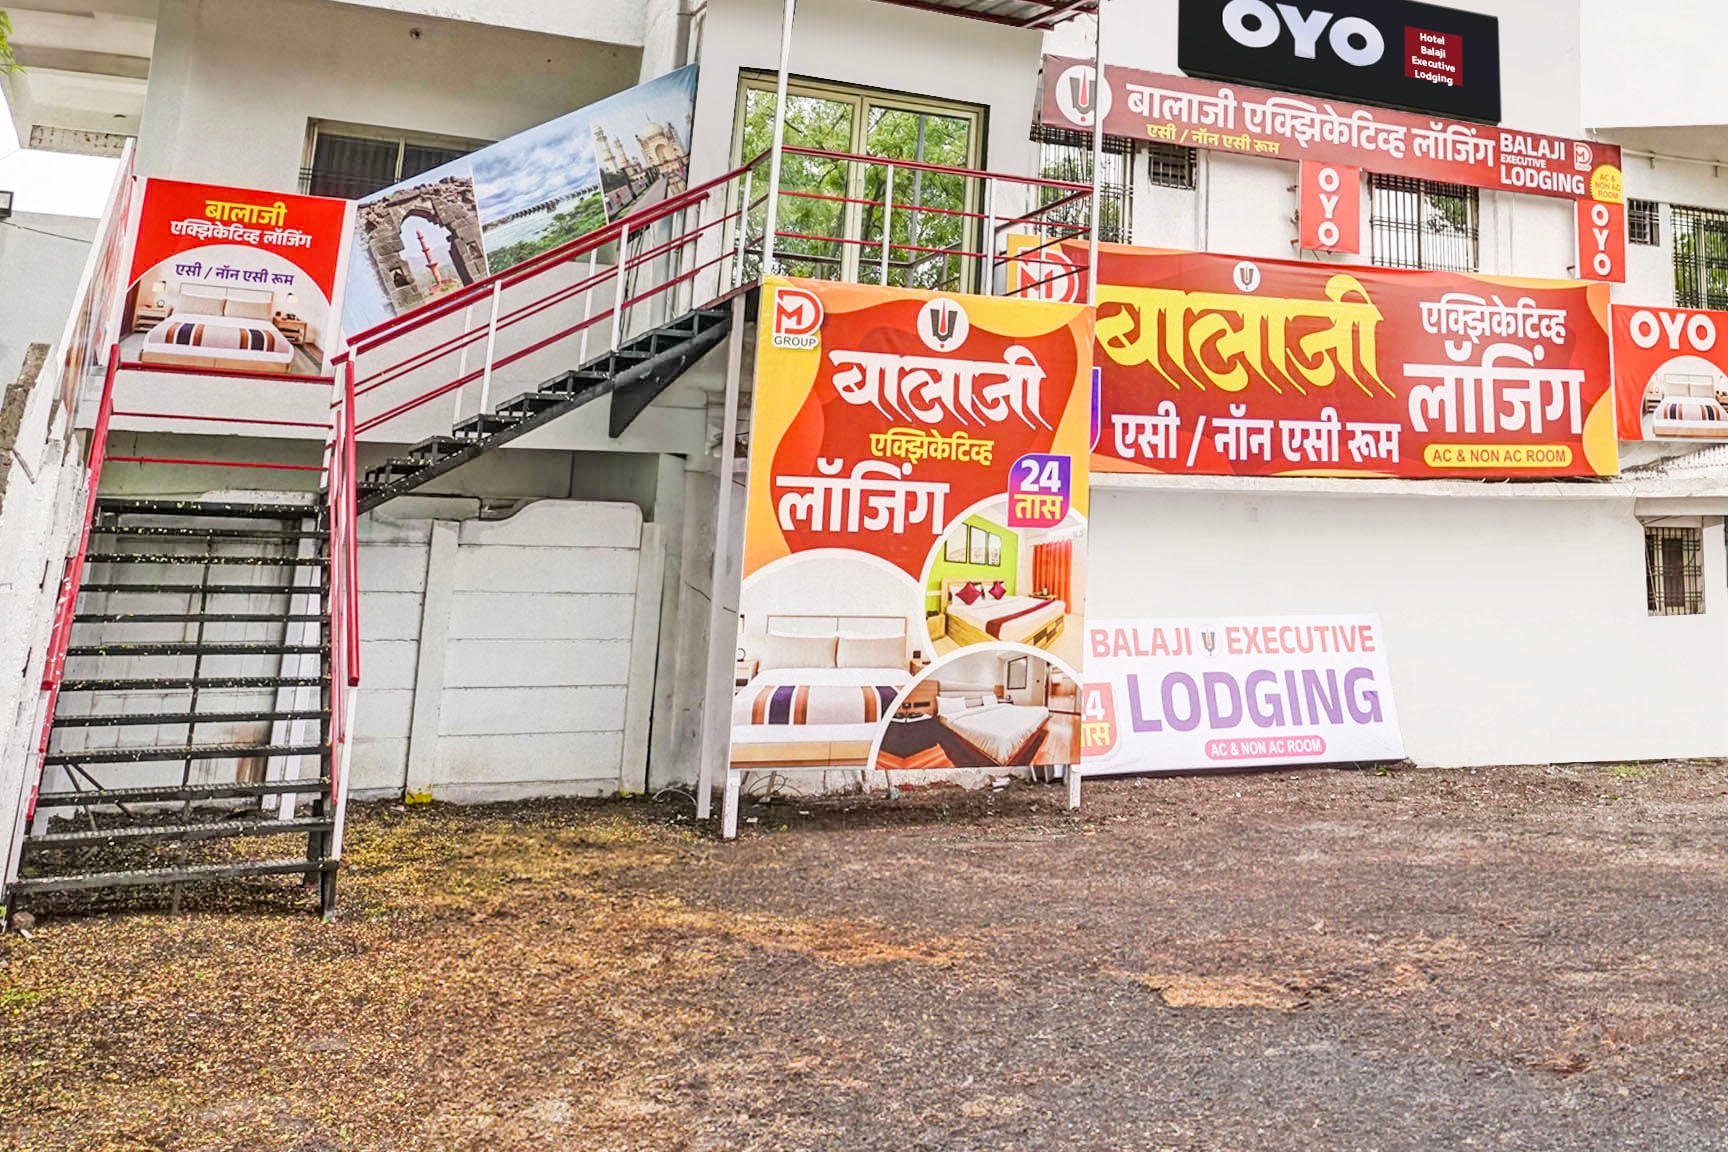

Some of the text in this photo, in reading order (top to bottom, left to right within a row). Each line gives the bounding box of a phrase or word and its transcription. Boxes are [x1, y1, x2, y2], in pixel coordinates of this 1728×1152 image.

[1419, 32, 1445, 45] Hotel
[1420, 45, 1446, 59] Balaji
[1411, 56, 1456, 73] Executive
[1414, 70, 1453, 87] Lodging
[1126, 86, 1496, 168] बालाजी एक्झिकेटिव्ह लॉजिंग
[1146, 123, 1178, 141] एसी
[1191, 127, 1220, 146] नॉन
[1222, 133, 1251, 151] एसी
[1253, 139, 1280, 155] रूम
[1500, 132, 1565, 160] BALAJI
[1500, 153, 1546, 168] EXECUTIVE
[1501, 165, 1585, 194] LODGING
[204, 200, 288, 227] बालाजी
[1317, 167, 1340, 247] OYO
[170, 219, 312, 249] एक्झिकेटिव्ह लॉजिंग
[1591, 204, 1611, 276] OYO
[175, 261, 202, 278] एसी
[215, 266, 240, 281] नॉन
[242, 269, 269, 284] एसी
[271, 273, 295, 286] रूम
[1419, 293, 1567, 345] एक्झिकेटिव्ह
[1629, 310, 1717, 352] OYO
[774, 335, 817, 348] GROUP
[1095, 274, 1397, 398] बालाजी
[828, 345, 1053, 431] बालाजी
[1403, 340, 1585, 434] लॉजिंग
[869, 427, 995, 466] एक्झिकेटिव्ह
[1111, 400, 1401, 467] एसी / नॉन एसी रूम
[1432, 449, 1566, 463] AC & NON AC ROOM
[1020, 459, 1062, 493] 24
[775, 457, 950, 535] लॉजिंग
[1013, 493, 1063, 520] तास
[1090, 624, 1376, 658] BALAJI EXECUTIVE
[1082, 689, 1105, 721] 4
[1126, 666, 1384, 733] LODGING
[1210, 737, 1322, 756] AC & NON AC ROOM
